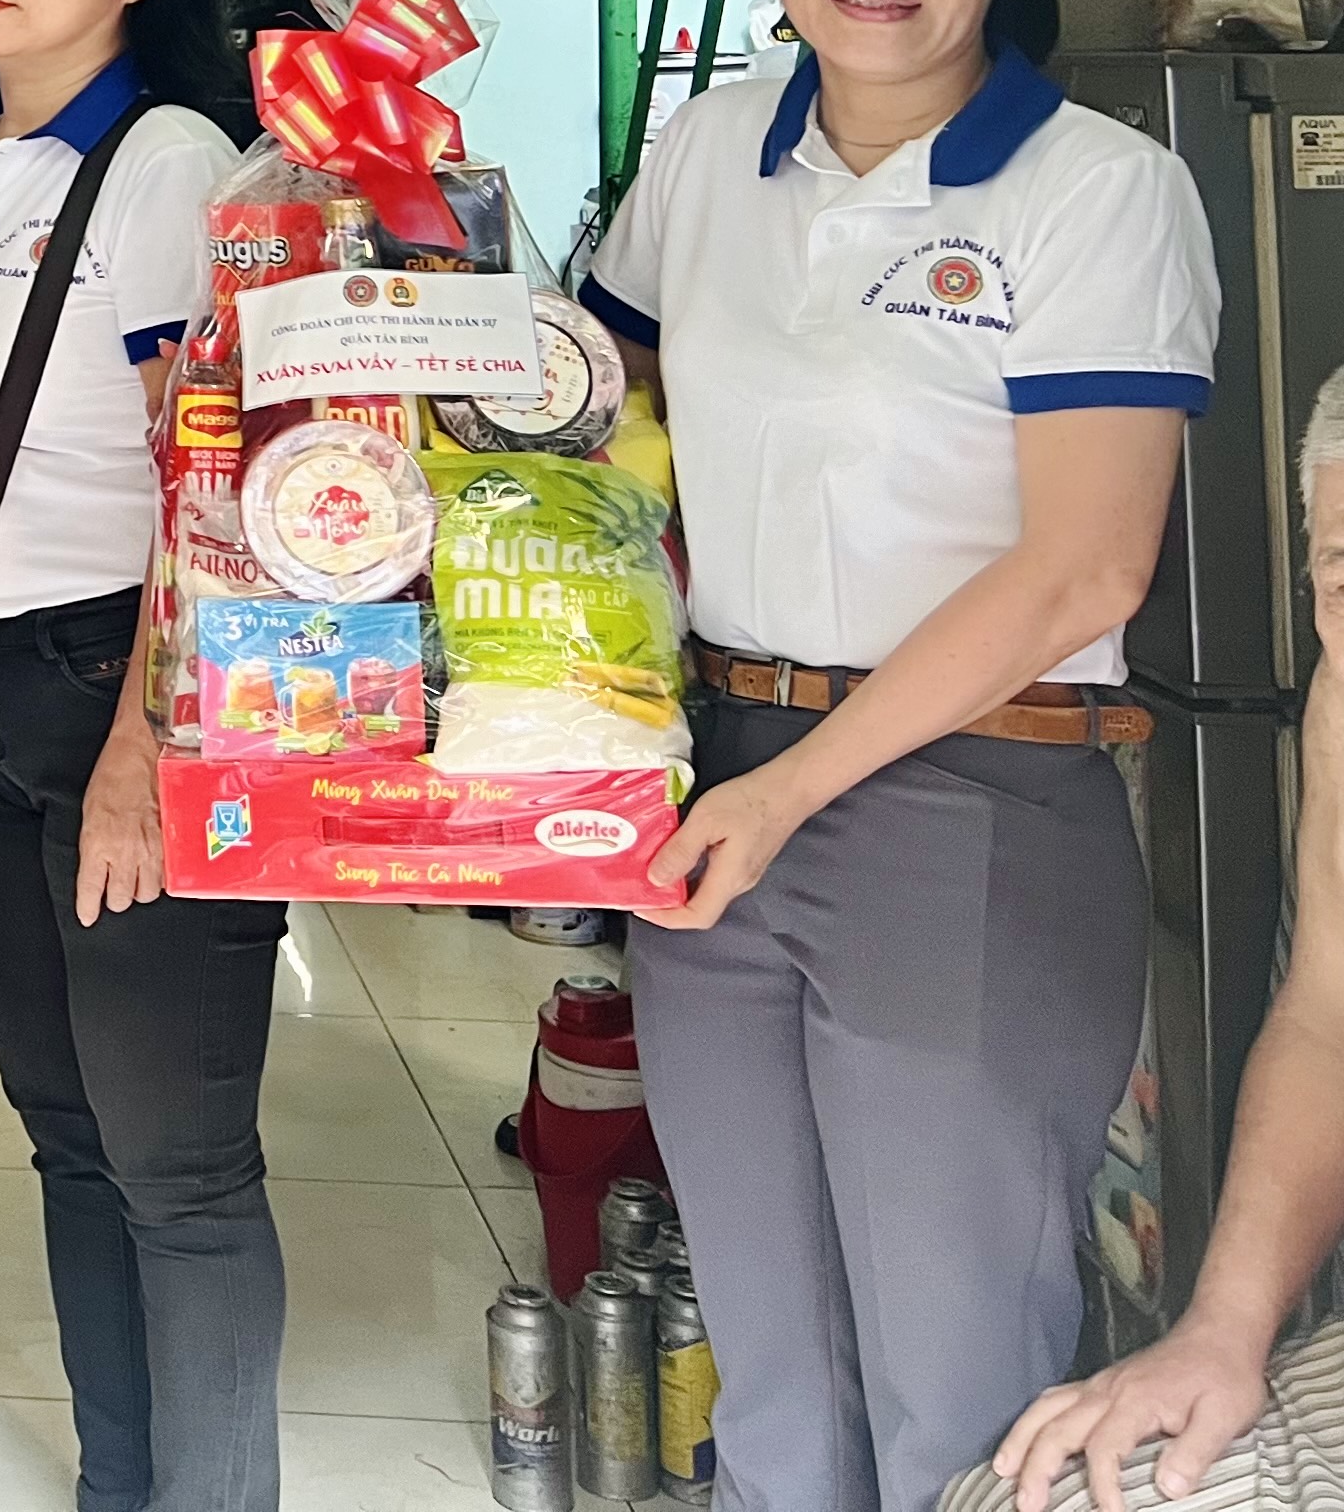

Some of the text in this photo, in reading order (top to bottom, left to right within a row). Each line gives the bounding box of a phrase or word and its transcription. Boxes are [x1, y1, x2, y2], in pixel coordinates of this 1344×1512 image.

[1299, 119, 1338, 129] AQUA
[272, 313, 497, 337] CÔNG ĐOÀN CHI CỤC THI HÀNH ÁN DÂN SỰ
[936, 307, 970, 326] TÂN
[975, 314, 1011, 334] BÌNH
[340, 332, 429, 347] QUẬN TÂN BÌNH
[256, 361, 305, 385] XUÂN
[310, 360, 352, 375] SUM
[482, 359, 526, 373] CHIA
[225, 616, 243, 641] 3
[278, 634, 344, 656] NESTEA
[370, 780, 419, 800] Xuân
[553, 820, 621, 838] Bidrico
[335, 861, 381, 887] Sung
